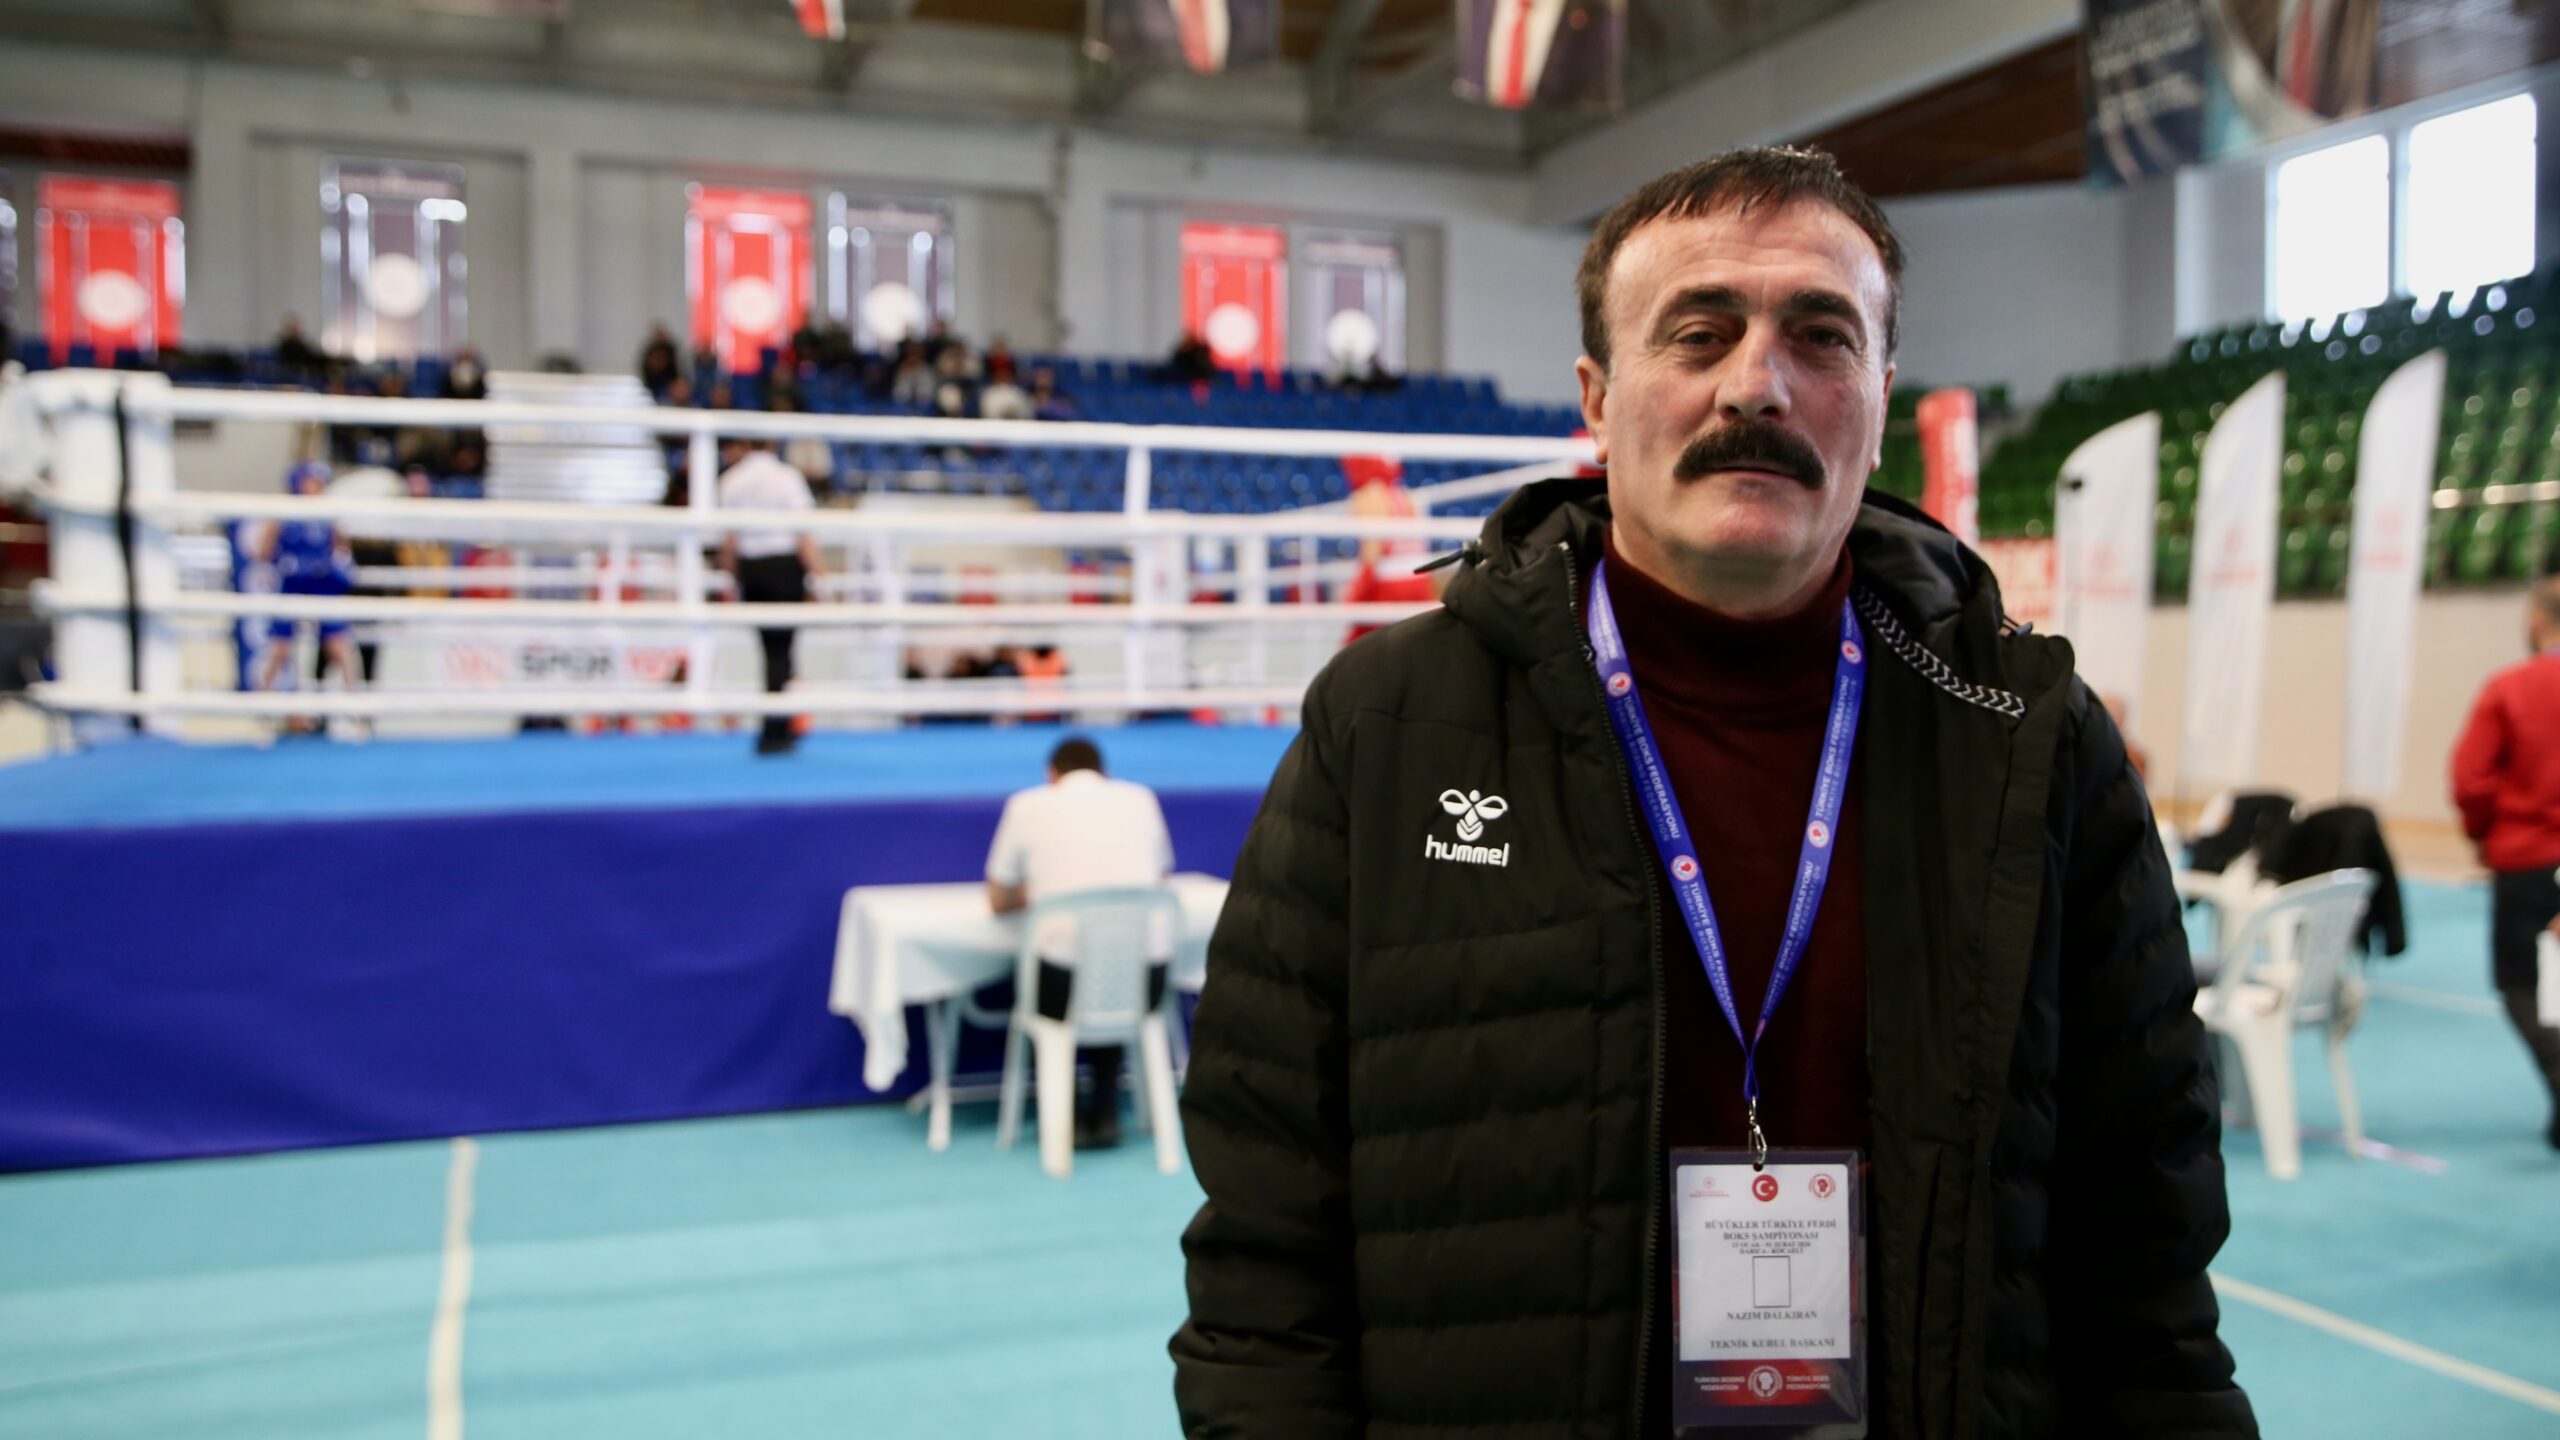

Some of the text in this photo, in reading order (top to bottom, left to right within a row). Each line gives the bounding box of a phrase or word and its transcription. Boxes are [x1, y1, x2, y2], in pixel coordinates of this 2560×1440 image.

[1624, 696, 1681, 839] TÜRKİYE BOKS FEDERASYONU
[1825, 747, 1837, 775] BOKS
[1425, 834, 1510, 867] hummel
[1690, 882, 1711, 926] TÜRKİYE
[1705, 927, 1720, 958] BOKS
[1778, 940, 1793, 970] BOKS
[1789, 861, 1814, 939] FEDERASYONU
[1704, 1219, 1837, 1230] BÜYÜKLER TÜRKİYE FERDİ
[1723, 1230, 1819, 1242] BOKS ŞAMPİYONASI
[1726, 1310, 1818, 1321] NAZIM DALKIRAN
[1709, 1338, 1836, 1349] TEKNİK KURUL BAŞKANI
